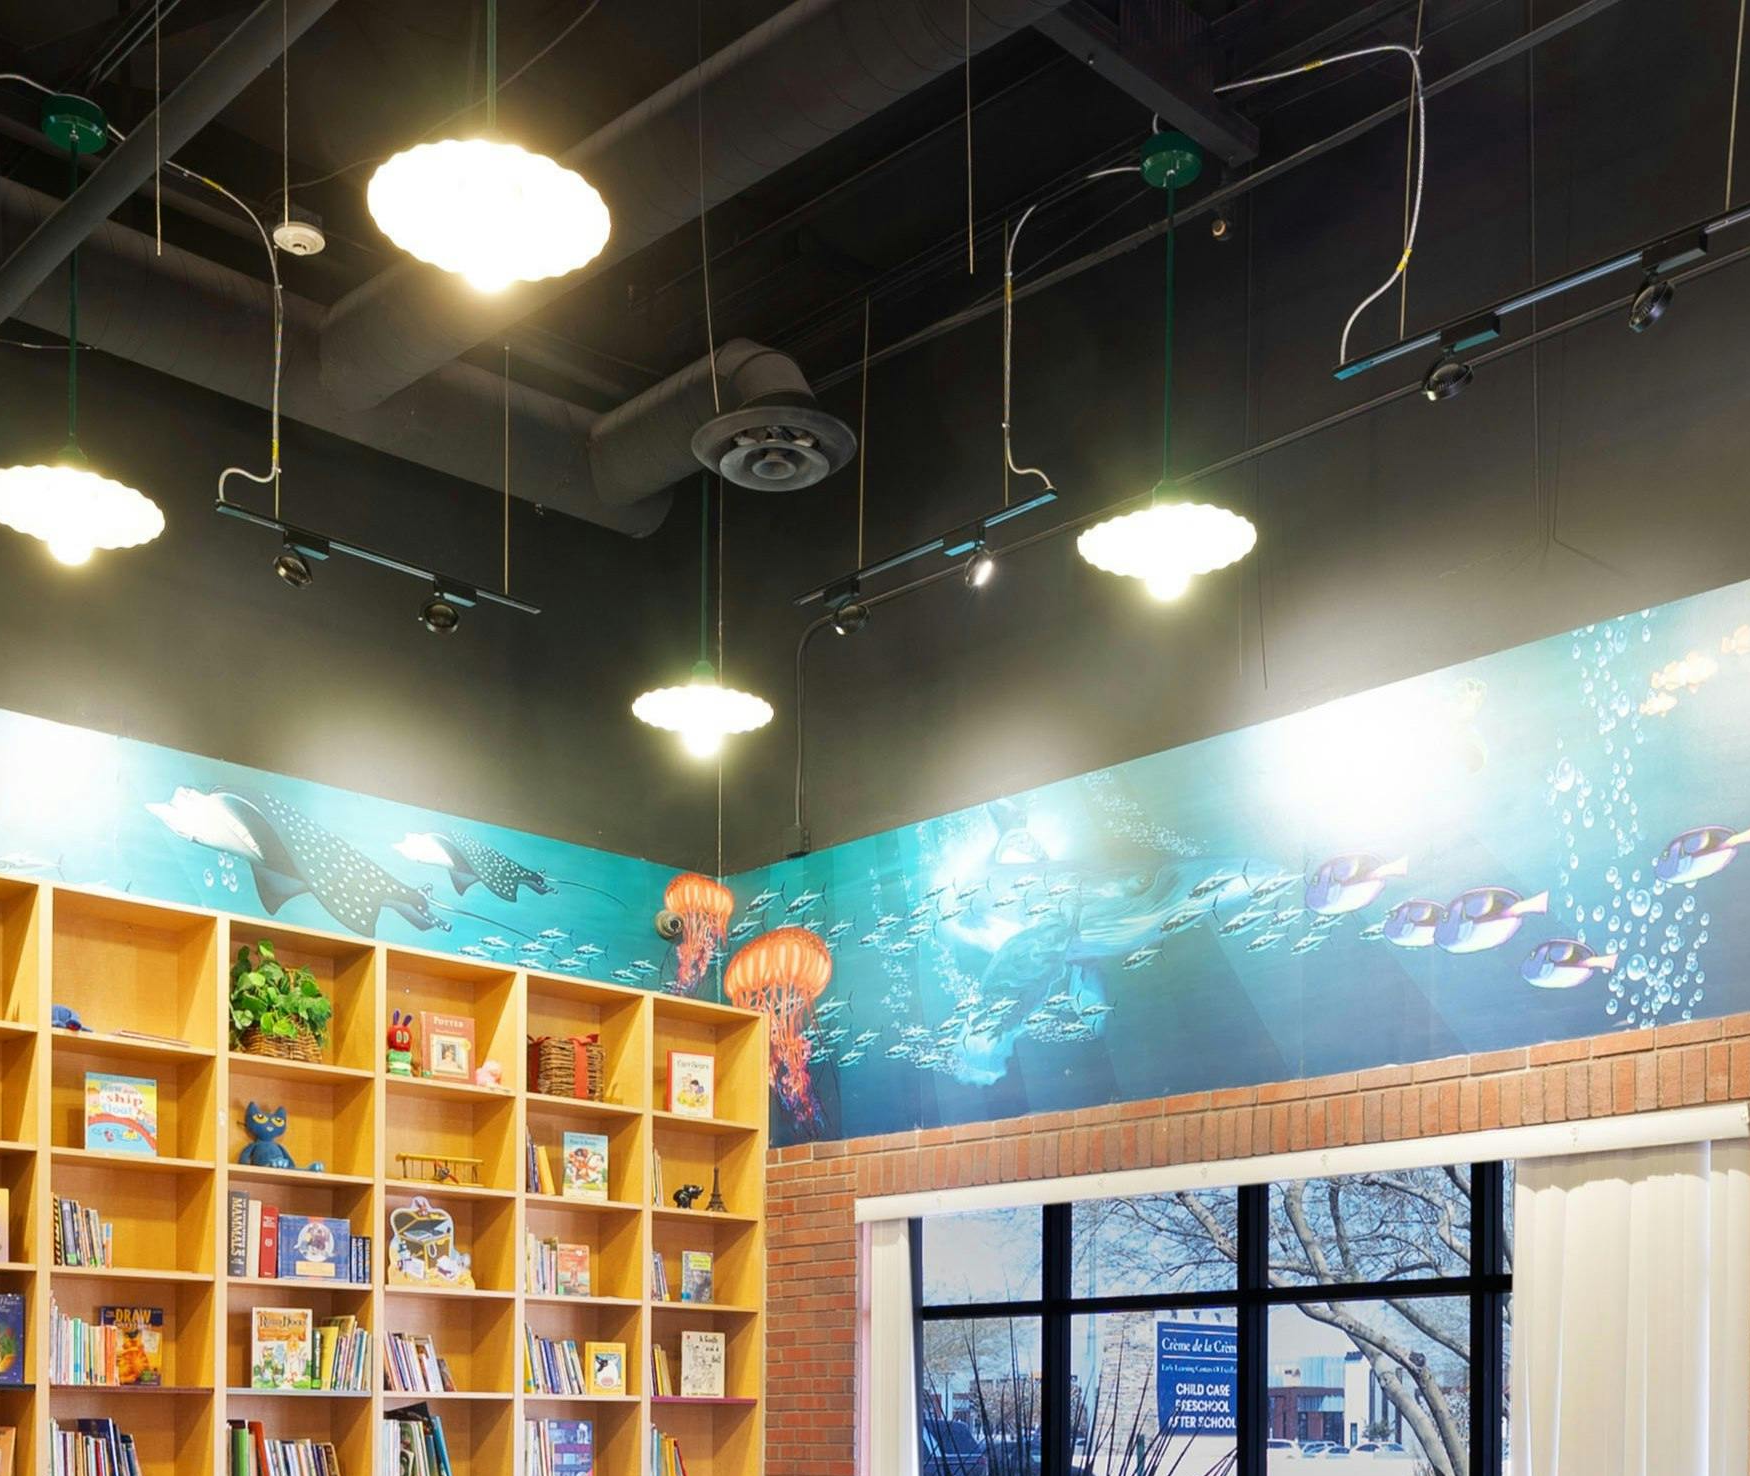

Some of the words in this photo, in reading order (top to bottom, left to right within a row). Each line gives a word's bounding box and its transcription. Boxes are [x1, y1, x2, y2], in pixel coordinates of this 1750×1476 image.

[231, 1196, 244, 1257] MAMMALS
[115, 1308, 152, 1324] DRAW
[1161, 1336, 1191, 1352] Crème
[1192, 1338, 1203, 1353] de
[1204, 1338, 1212, 1353] la
[1213, 1340, 1238, 1354] Crèm
[1175, 1382, 1205, 1396] CHILD
[1205, 1384, 1231, 1397] CARE
